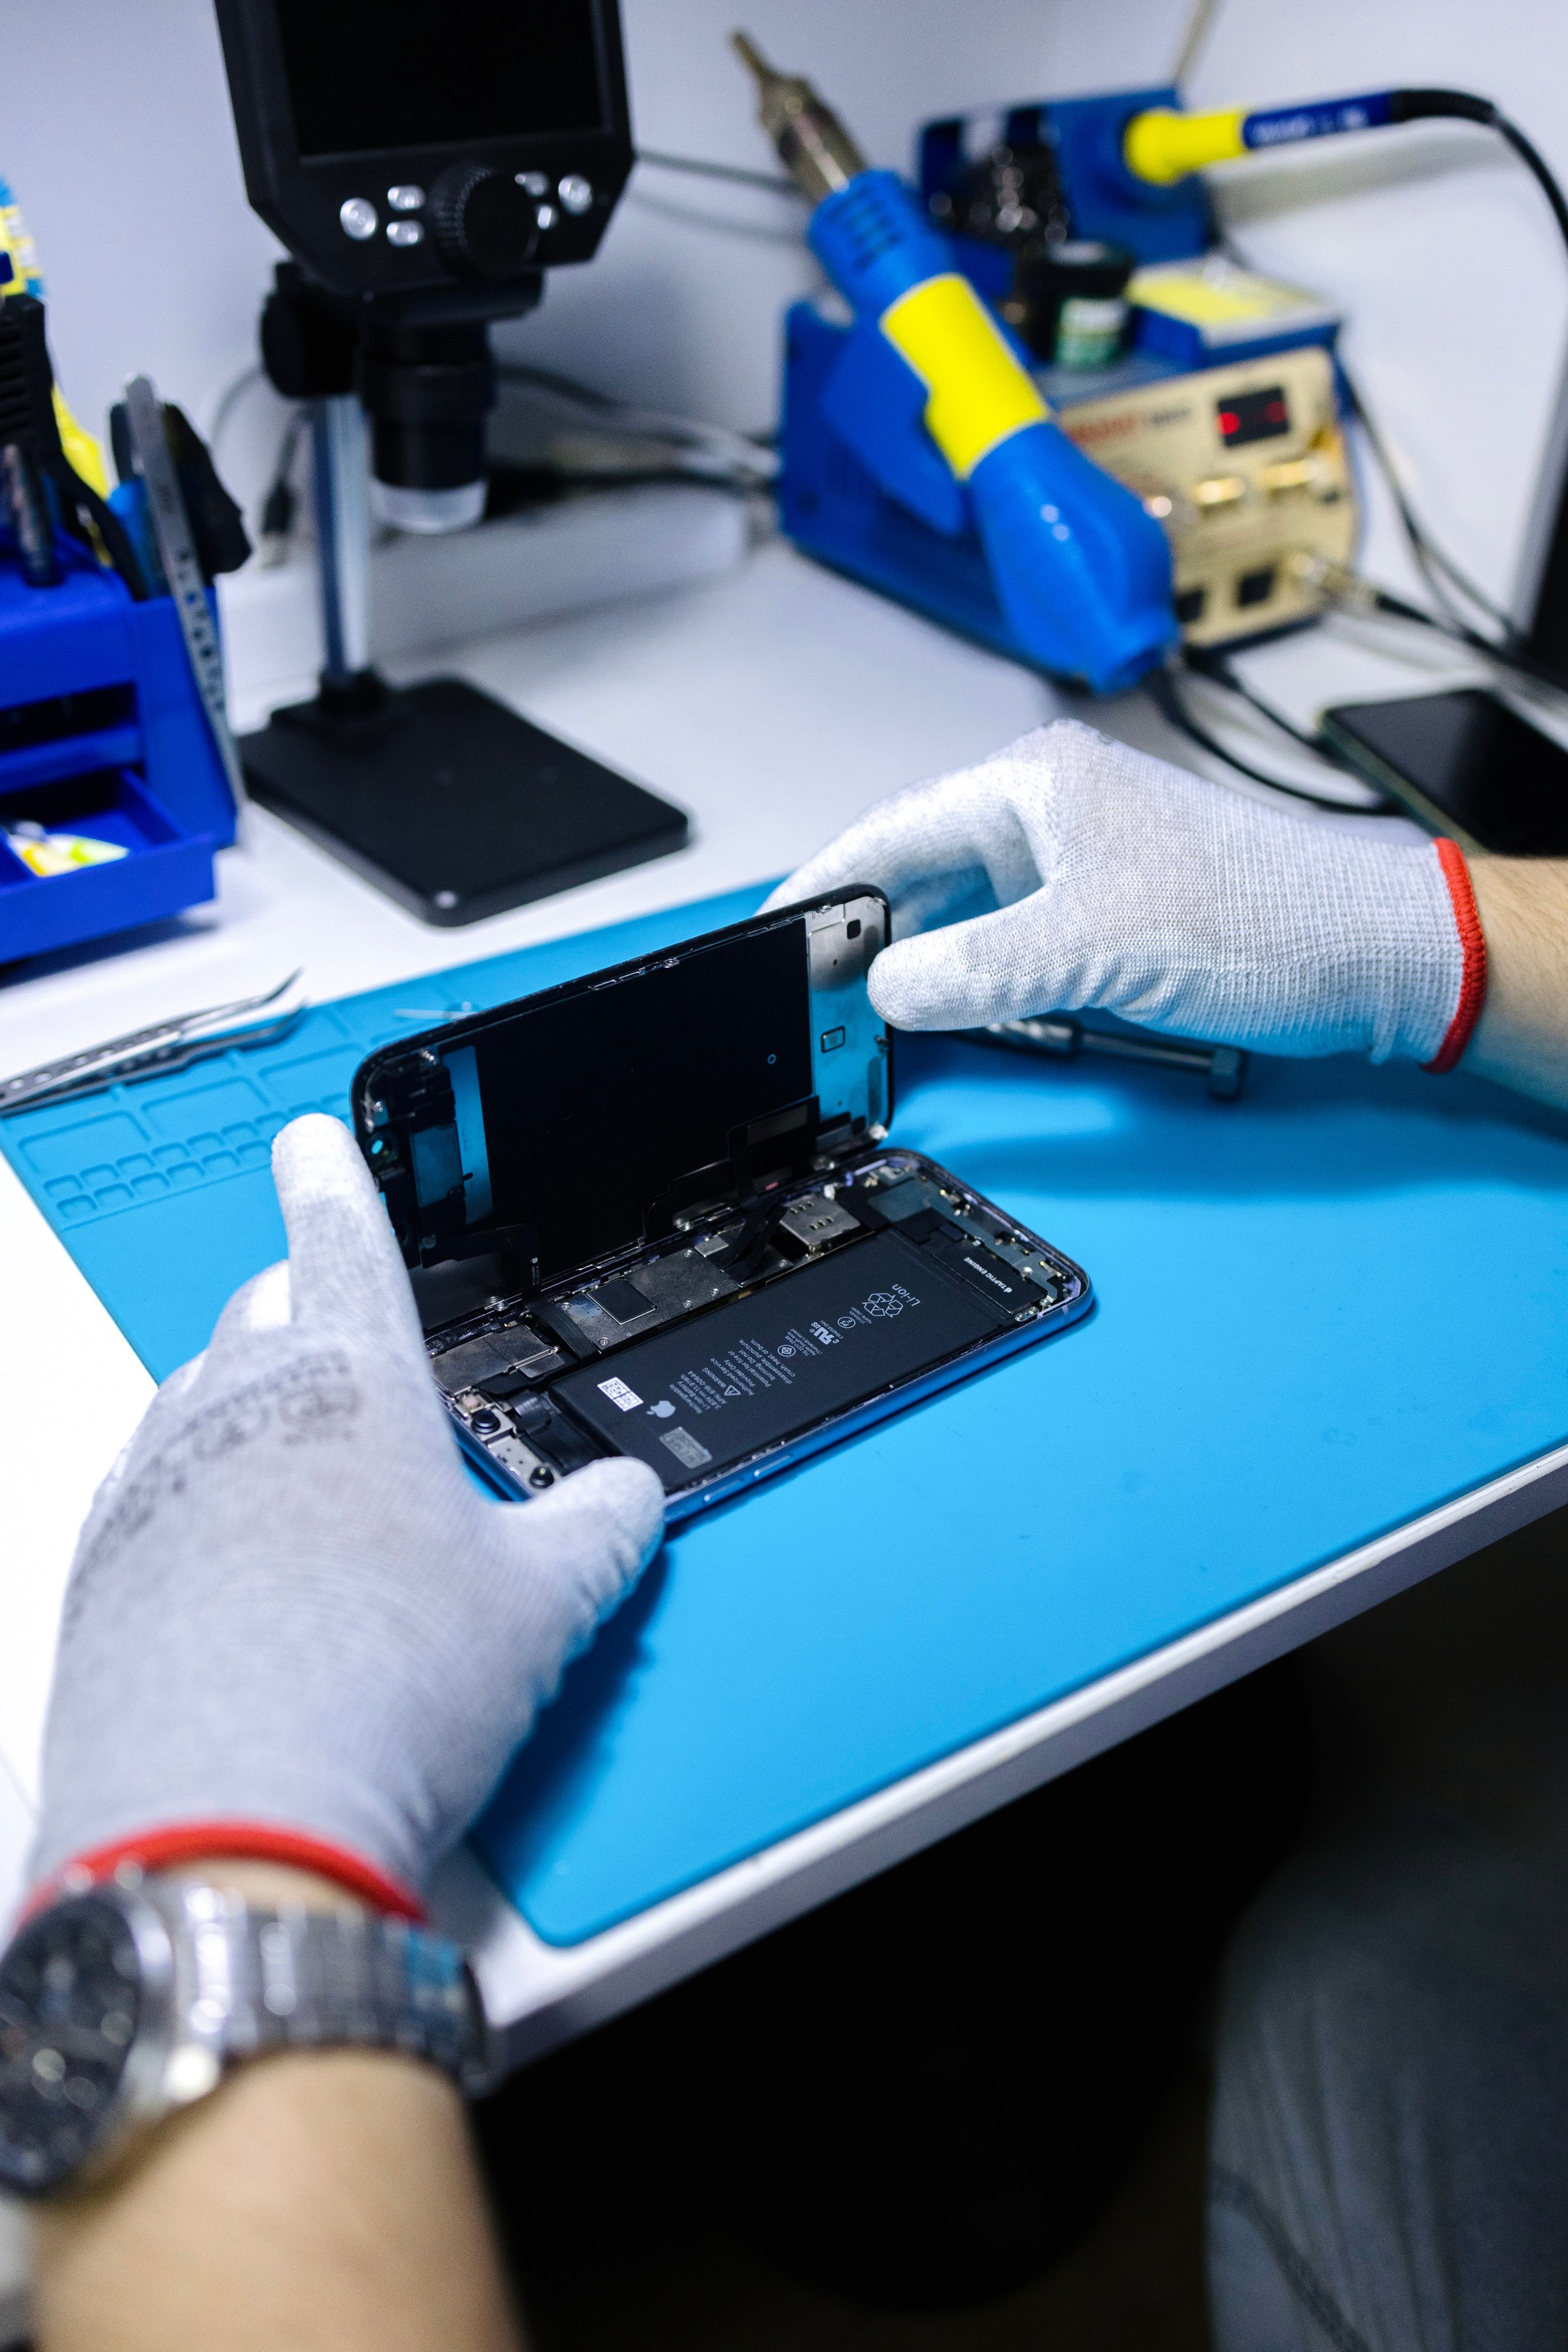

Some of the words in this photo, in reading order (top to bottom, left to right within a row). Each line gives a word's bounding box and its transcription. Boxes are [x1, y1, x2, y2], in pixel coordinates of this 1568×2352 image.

[963, 1257, 988, 1275] ENGINE
[985, 1273, 1007, 1289] TAPTIC
[892, 1284, 921, 1306] Li-ion
[851, 1306, 863, 1316] Japan
[861, 1315, 873, 1324] Apple
[790, 1329, 805, 1341] Limited
[794, 1338, 807, 1348] South
[739, 1338, 763, 1359] puncture,
[750, 1338, 764, 1351] burn.
[803, 1339, 823, 1354] (Thailand)
[805, 1346, 816, 1355] Apple
[733, 1355, 744, 1363] fire
[738, 1349, 749, 1358] not
[767, 1353, 781, 1365] heat,
[710, 1358, 729, 1374] Service
[723, 1359, 736, 1370] Only
[755, 1362, 776, 1381] burning.
[761, 1357, 793, 1384] disassemble,
[780, 1363, 796, 1377] crush,
[687, 1371, 716, 1395] 616-00644
[702, 1367, 726, 1389] WARNING
[726, 1372, 755, 1396] Authorized
[734, 1369, 756, 1387] Provider
[747, 1368, 772, 1387] Potential
[677, 1381, 696, 1398] Battery
[669, 1384, 703, 1414] Rechargeable
